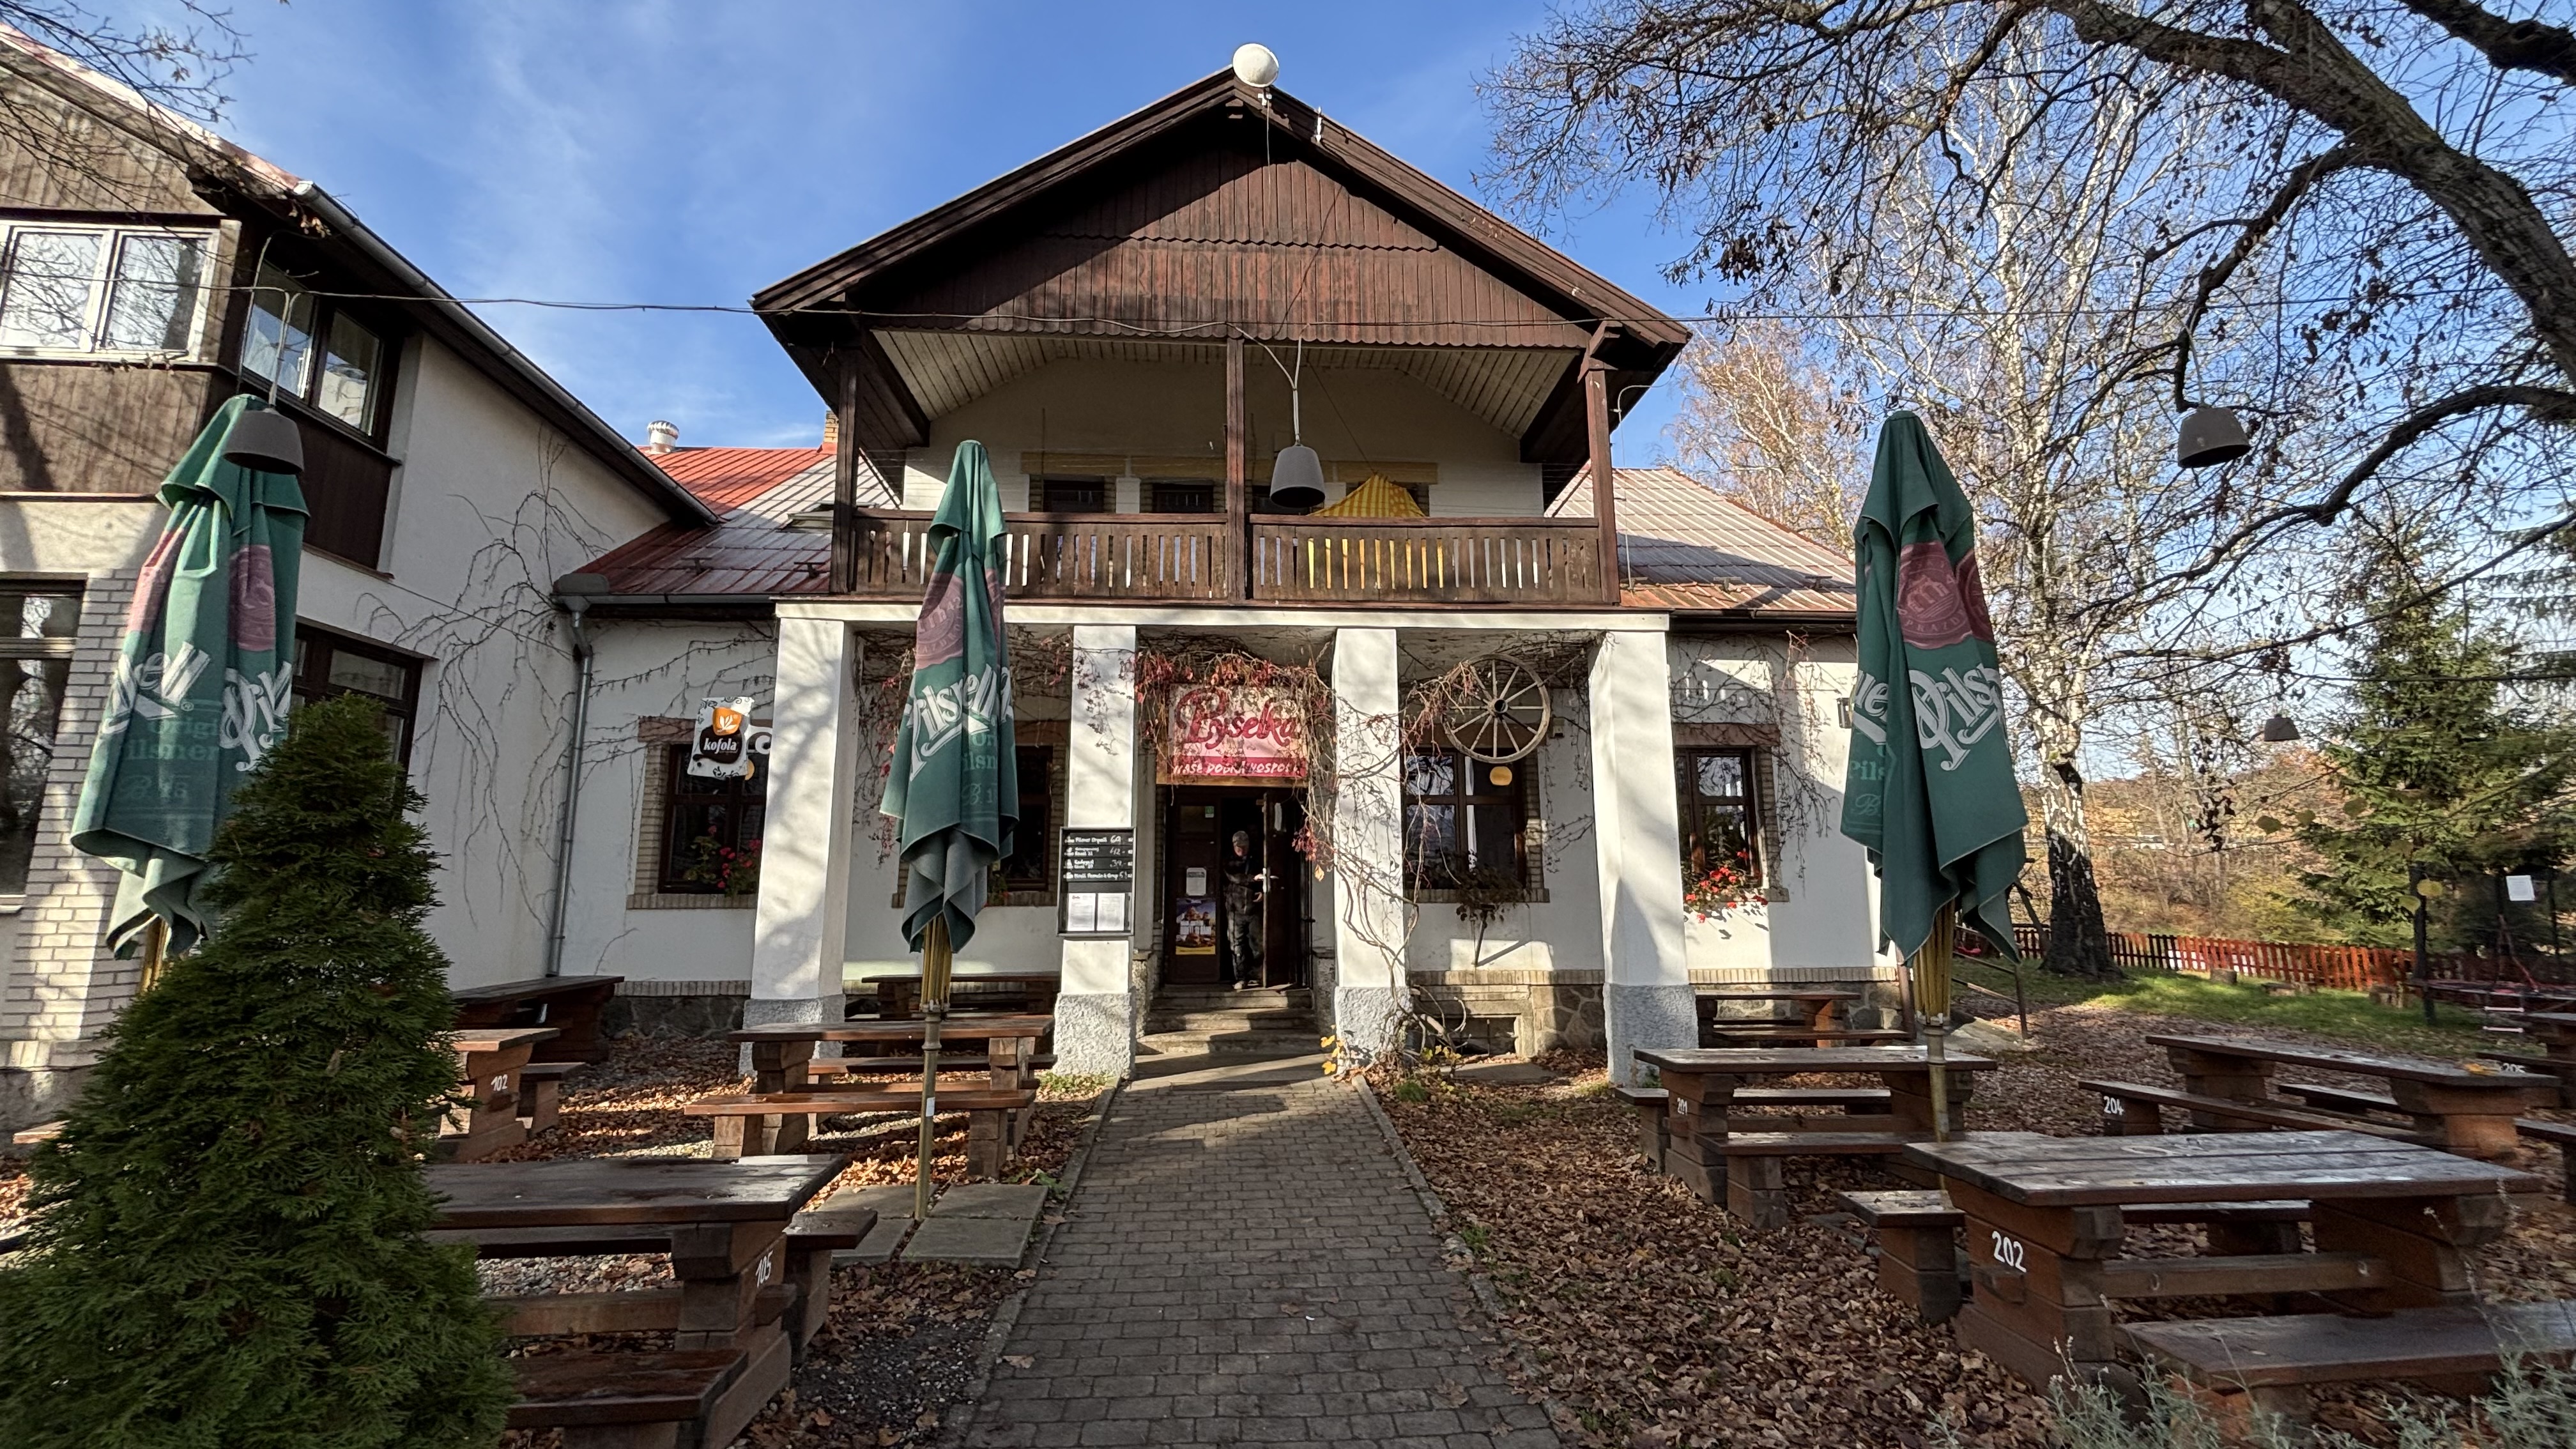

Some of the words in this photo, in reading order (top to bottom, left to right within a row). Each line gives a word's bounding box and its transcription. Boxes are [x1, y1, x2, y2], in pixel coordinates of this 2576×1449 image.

[703, 737, 739, 754] kofola
[491, 1074, 508, 1091] 102
[2103, 1095, 2124, 1116] 204
[1991, 1230, 2027, 1273] 202
[755, 1250, 774, 1288] 105
